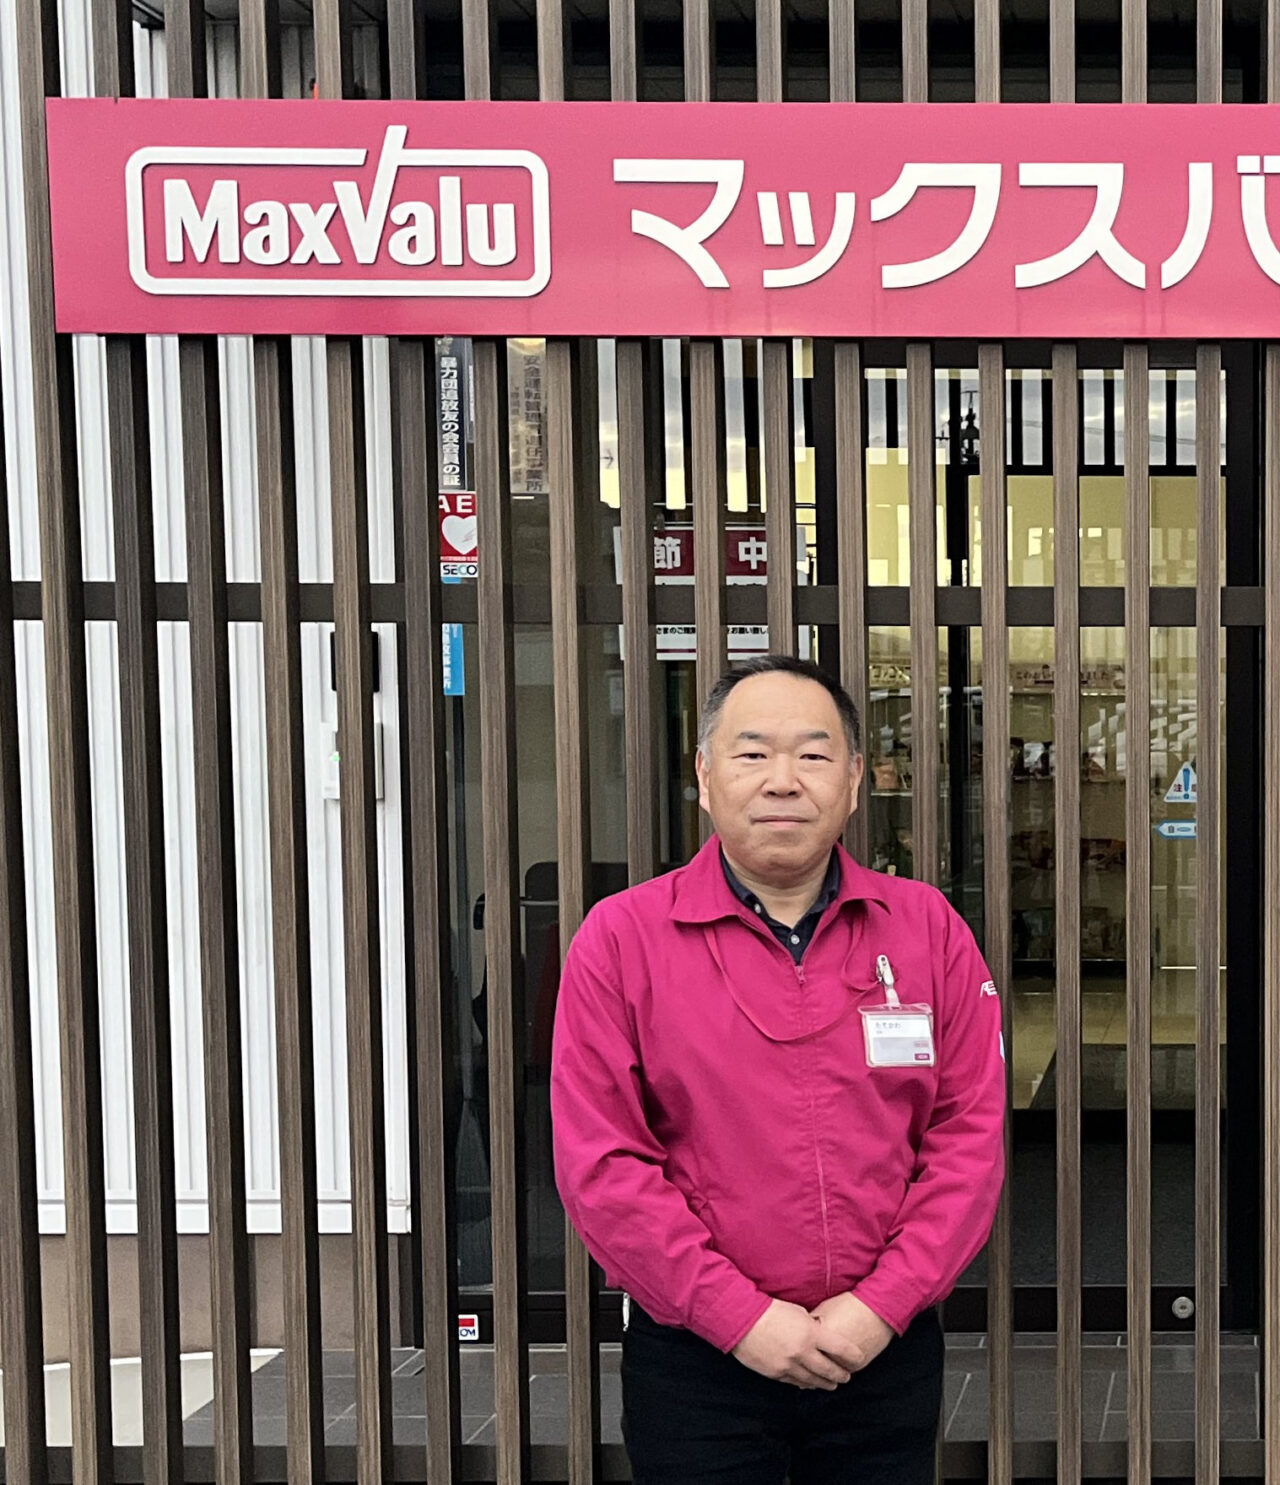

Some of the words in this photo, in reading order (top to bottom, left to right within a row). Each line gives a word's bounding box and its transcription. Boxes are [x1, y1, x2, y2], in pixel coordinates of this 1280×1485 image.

[164, 125, 516, 266] MaxValu
[439, 495, 473, 513] AE
[443, 564, 478, 576] SECO
[980, 980, 998, 998] AE
